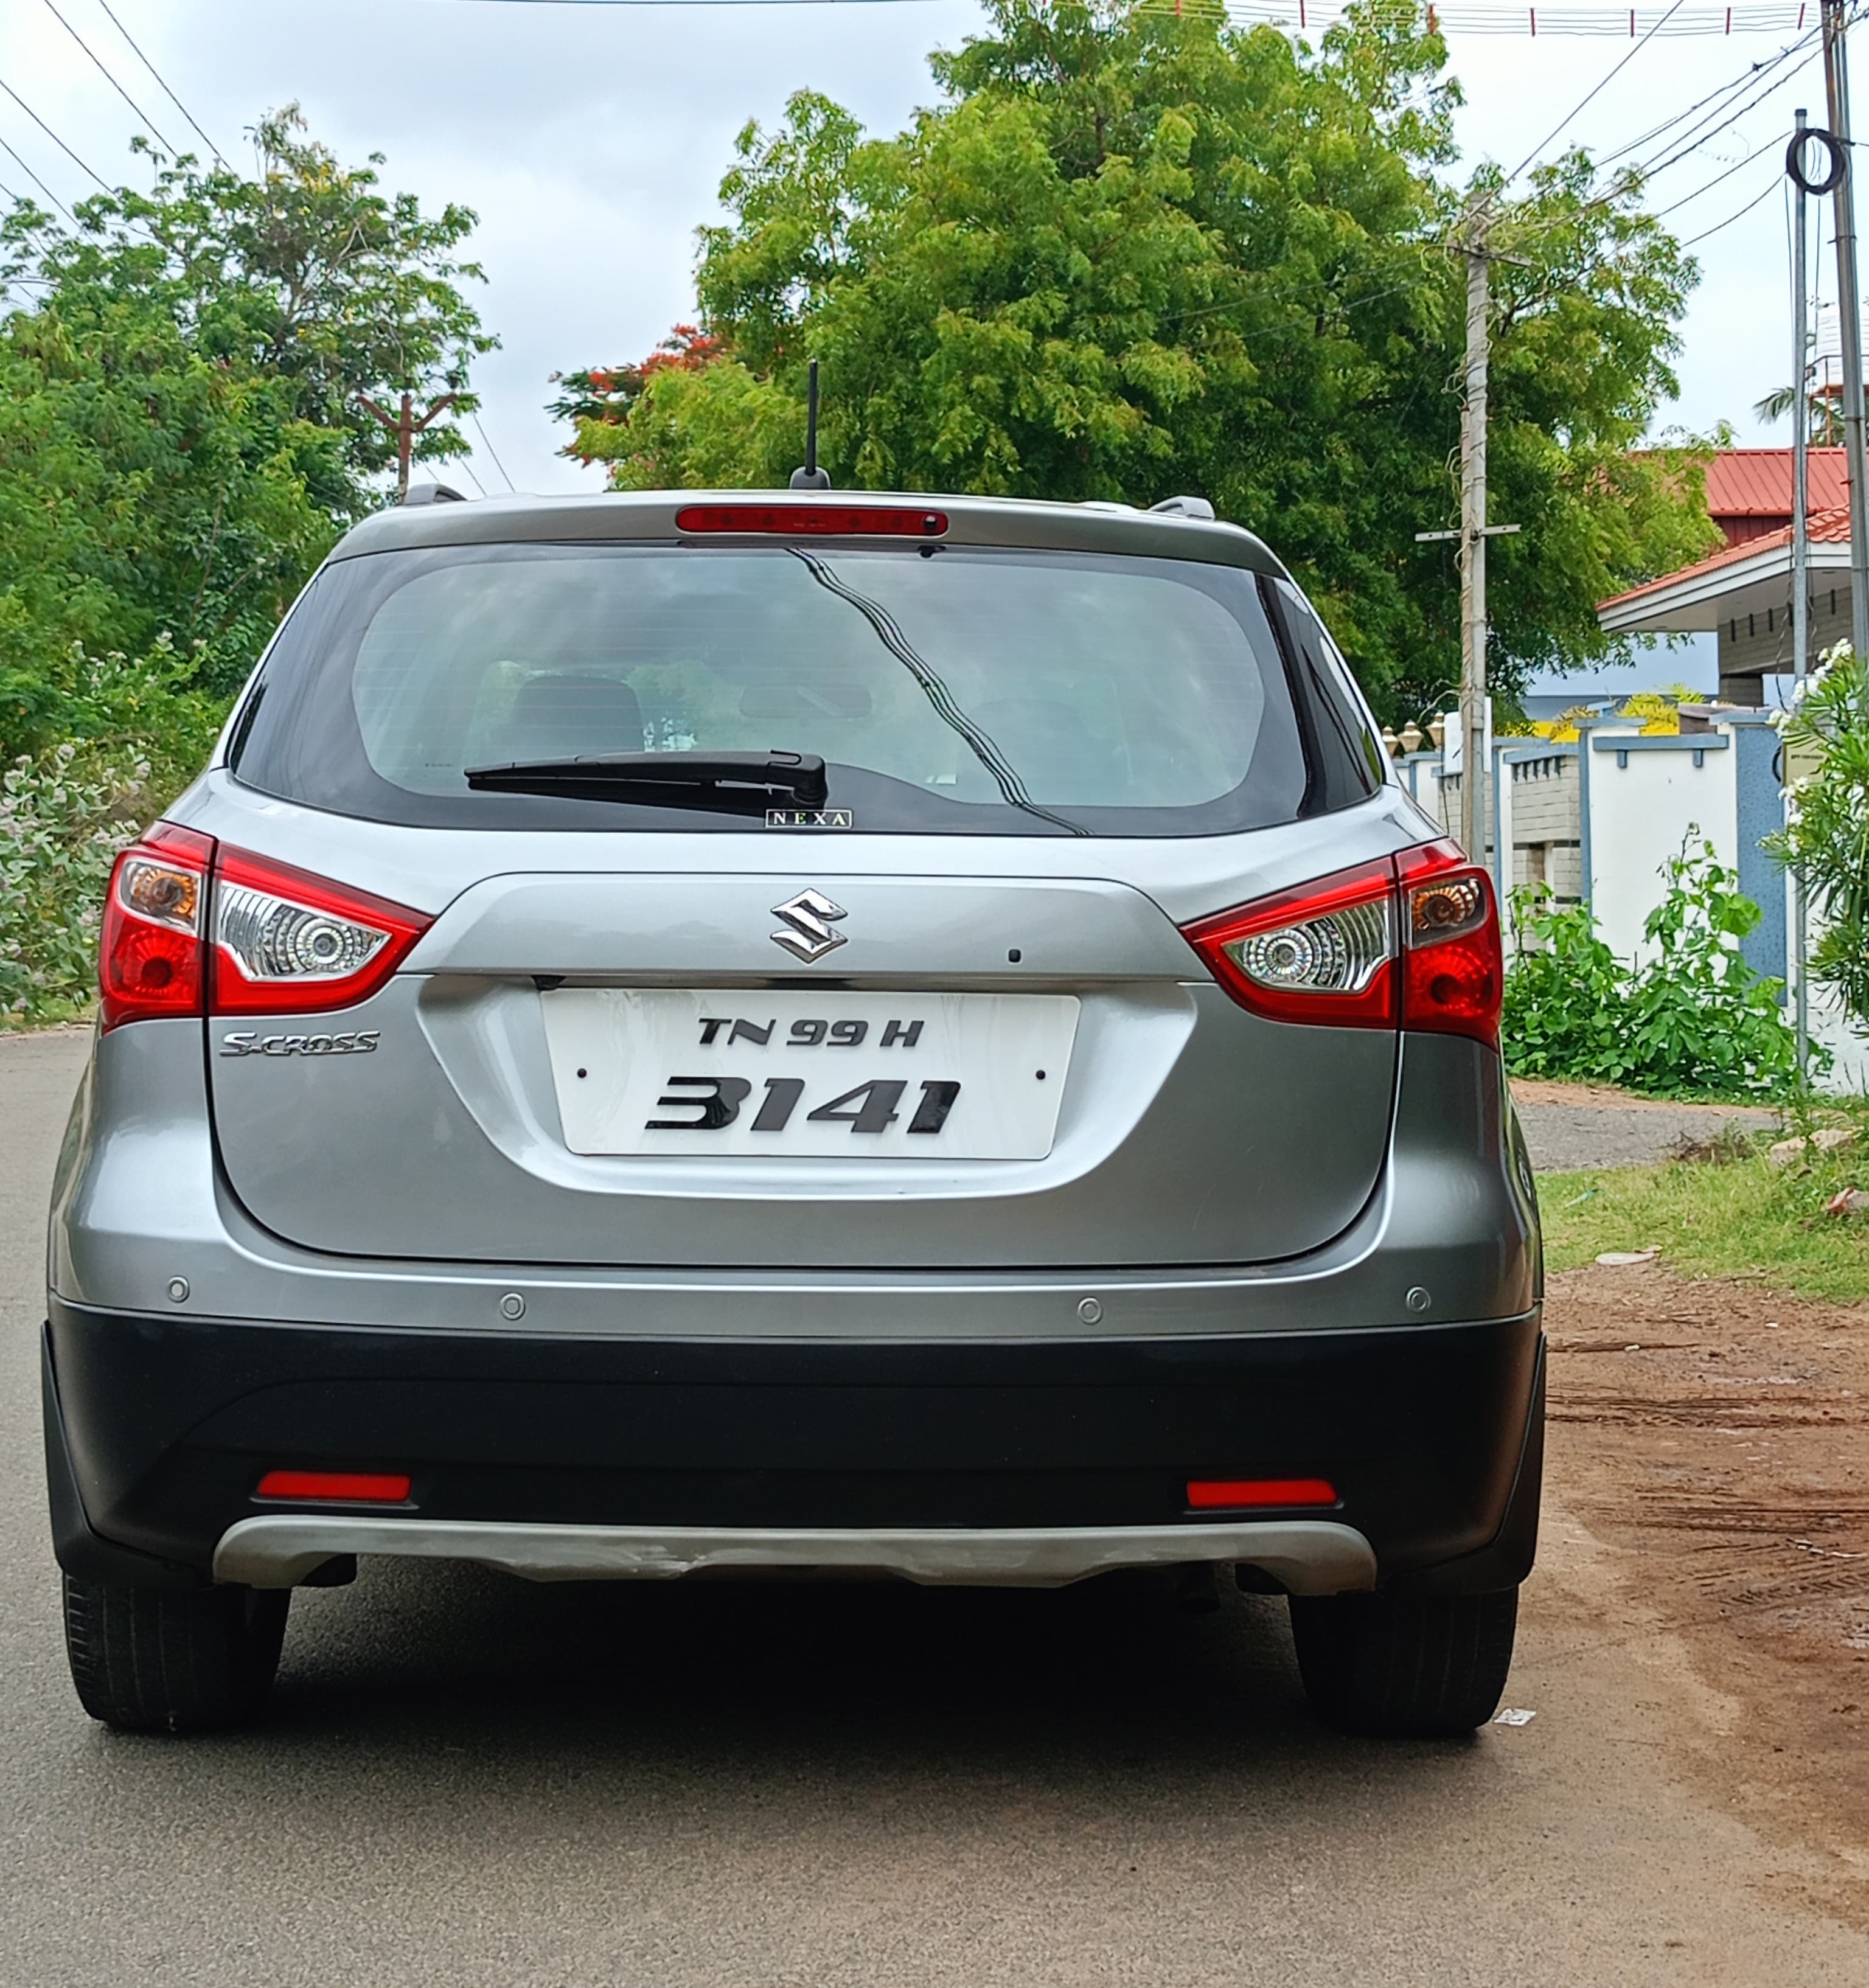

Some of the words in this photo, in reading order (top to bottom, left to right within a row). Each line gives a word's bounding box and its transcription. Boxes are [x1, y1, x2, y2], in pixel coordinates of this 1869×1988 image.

[773, 812, 846, 825] NEXA
[219, 1030, 381, 1056] S-CROSS
[698, 1018, 776, 1046] TN
[786, 1020, 869, 1047] 99
[879, 1020, 925, 1048] H
[644, 1076, 961, 1135] 3141
